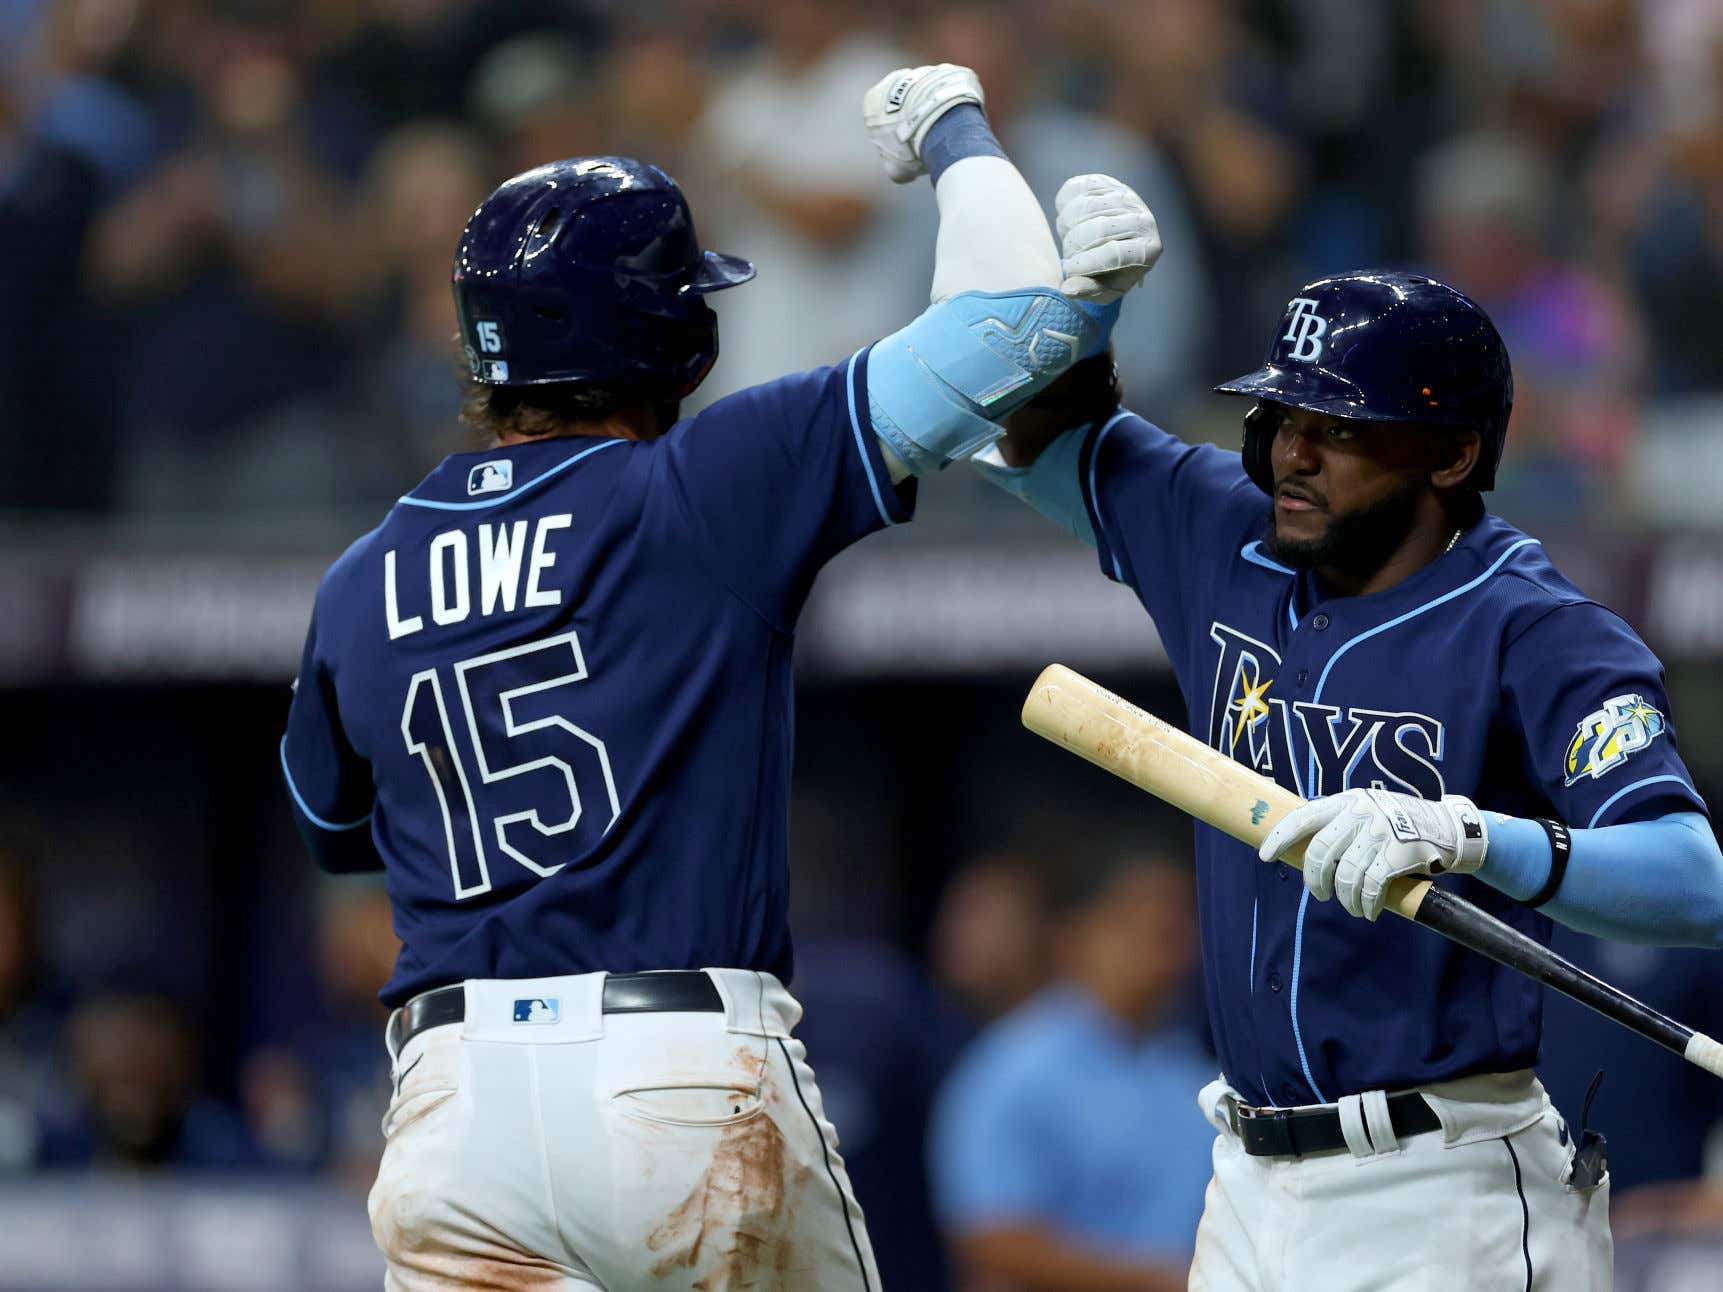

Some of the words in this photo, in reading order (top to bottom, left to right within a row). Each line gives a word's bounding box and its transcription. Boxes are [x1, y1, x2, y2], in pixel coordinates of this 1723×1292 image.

[476, 321, 501, 353] 15
[1282, 297, 1328, 362] TB
[384, 513, 572, 640] LOWE
[1208, 621, 1446, 801] RAYS
[1581, 693, 1648, 779] 25
[401, 631, 621, 900] 15
